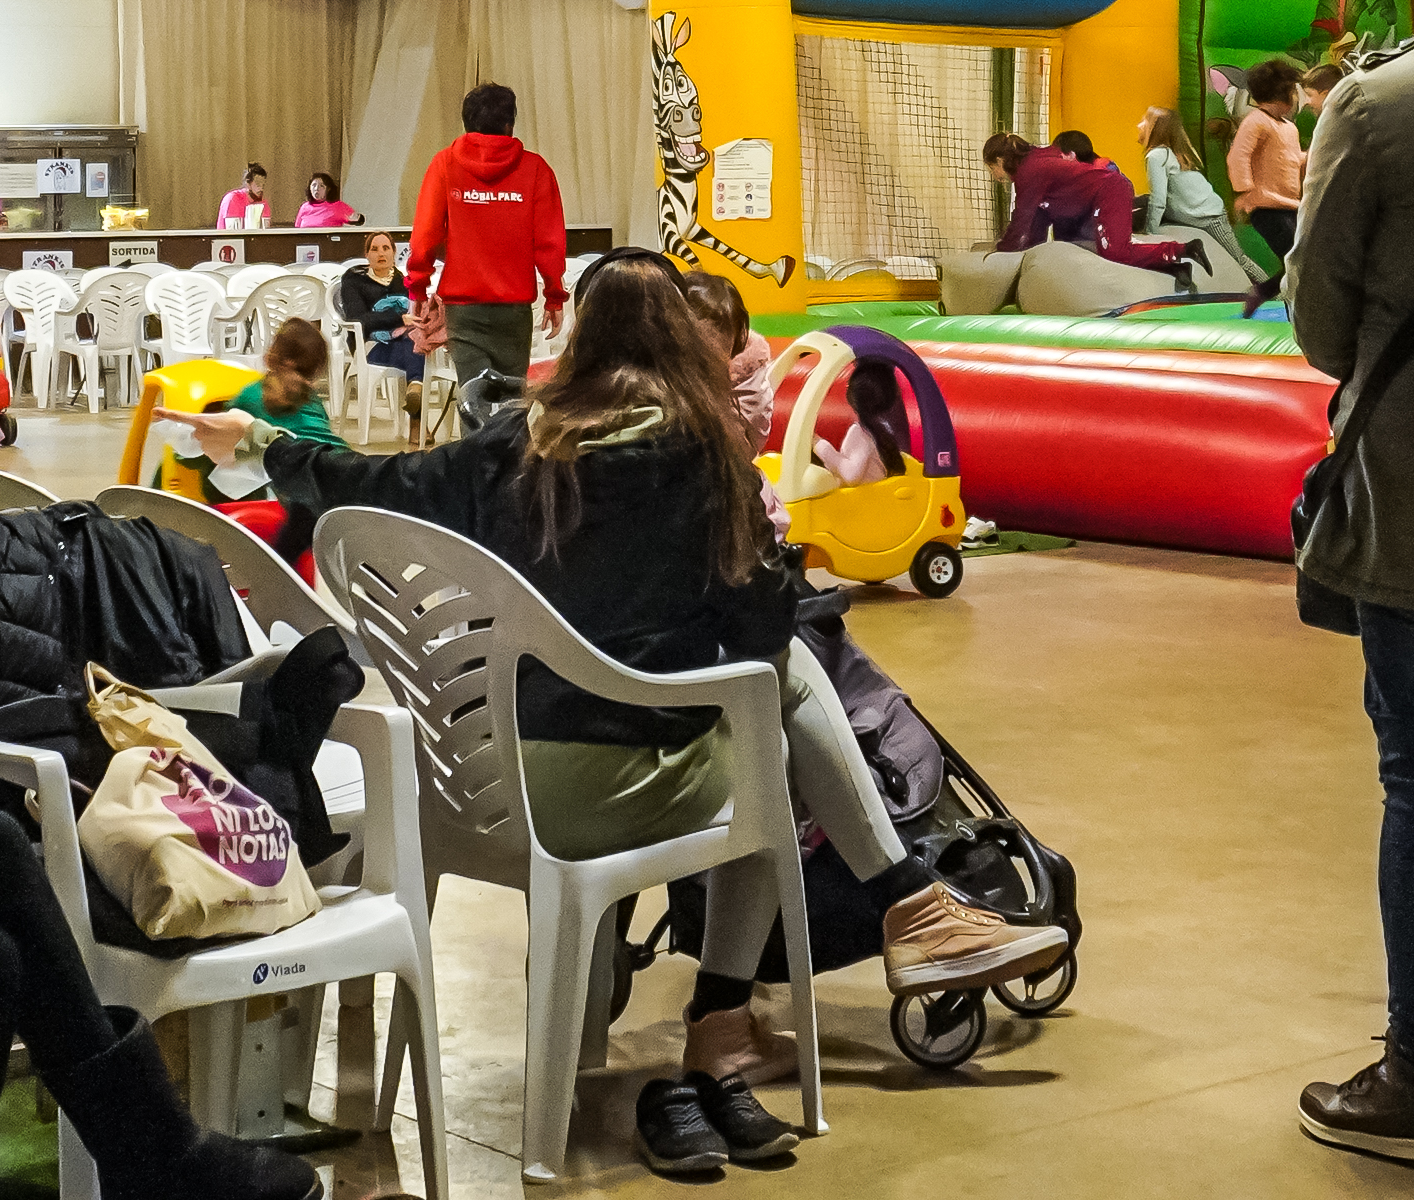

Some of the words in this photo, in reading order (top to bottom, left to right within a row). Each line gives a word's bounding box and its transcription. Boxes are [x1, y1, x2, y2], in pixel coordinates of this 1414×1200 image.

[498, 191, 524, 202] PARC
[111, 247, 156, 256] SORTIDA
[210, 806, 241, 833] NI
[218, 831, 286, 865] NOTAS
